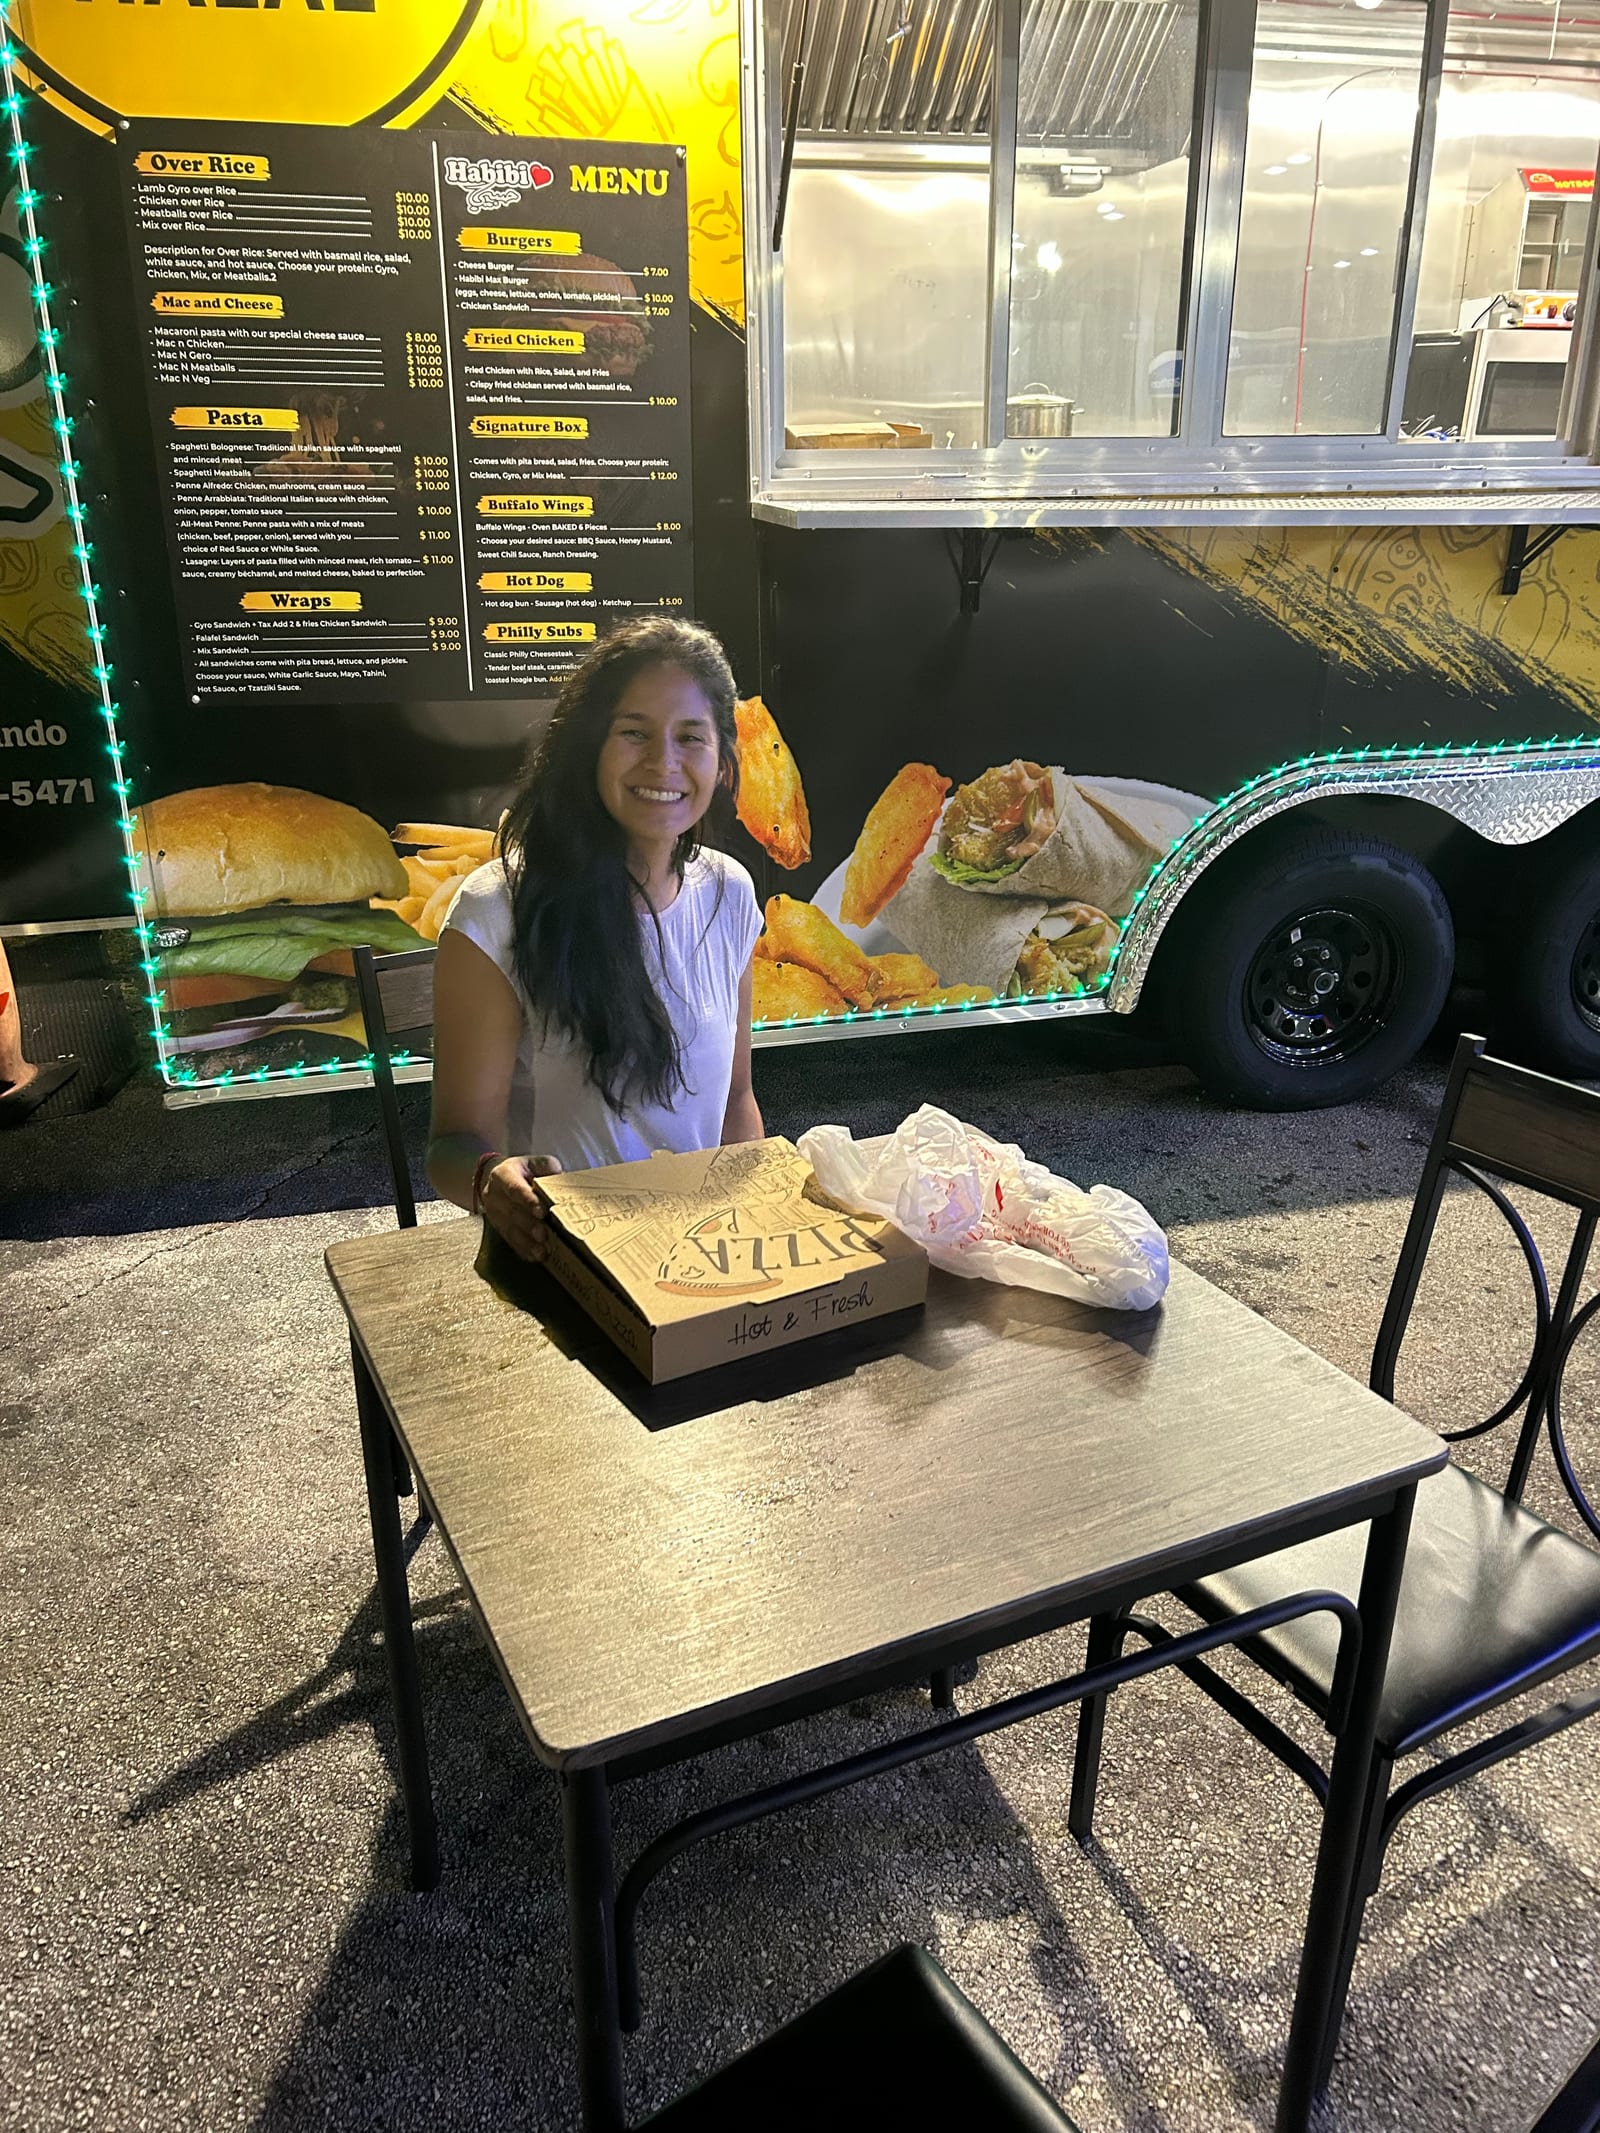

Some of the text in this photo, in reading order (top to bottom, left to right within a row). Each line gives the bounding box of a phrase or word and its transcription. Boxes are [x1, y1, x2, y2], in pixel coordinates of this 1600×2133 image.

[150, 154, 255, 174] Over Rice
[445, 158, 530, 186] Habibi
[569, 165, 669, 196] MENU
[137, 183, 429, 204] Lamb Gyro over Rice $10.00
[139, 195, 430, 216] Chicken over Rice $10.00
[140, 208, 431, 228] Meatballs over Rice $10.00
[142, 220, 432, 240] Mix over Rice $10.00
[487, 232, 552, 250] Burgers
[144, 244, 412, 265] Description for Over Rice: Served with basmati rice, salad,
[145, 256, 399, 276] white sauce, and hot sauce. Choose your protein: Gyro,
[458, 260, 487, 270] Cheese
[487, 261, 515, 272] Burger
[147, 269, 189, 281] Chicken,
[190, 270, 210, 281] Mix,
[211, 272, 222, 280] or
[458, 274, 529, 286] Habibi Max Burger
[161, 296, 273, 310] Mac and Cheese
[460, 301, 492, 311] Chicken
[492, 302, 530, 312] Sandwich
[154, 326, 199, 336] Macaroni
[200, 328, 227, 338] pasta
[227, 328, 250, 338] with
[251, 330, 268, 338] our
[269, 329, 302, 340] special
[303, 330, 336, 340] cheese
[337, 333, 365, 341] sauce
[474, 333, 574, 347] Fried Chicken
[156, 338, 176, 348] Mac
[178, 340, 185, 348] n
[186, 339, 225, 349] Chicken
[157, 350, 178, 360] Mac
[179, 351, 187, 360] N
[159, 362, 179, 371] Mac
[180, 362, 189, 371] N
[190, 363, 236, 372] Meatballs
[160, 374, 181, 383] Mac
[182, 374, 190, 383] N
[191, 374, 211, 385] Veg
[466, 394, 489, 404] salad,
[489, 395, 504, 403] and
[504, 395, 523, 403] fries.
[206, 409, 264, 426] Pasta
[476, 419, 582, 435] Signature Box
[173, 456, 189, 464] and
[190, 455, 221, 464] minced
[173, 469, 213, 478] Spaghetti
[213, 469, 252, 477] Meatballs
[469, 471, 502, 480] Chicken,
[502, 472, 522, 481] Gyro,
[531, 471, 545, 479] Mix
[545, 472, 566, 480] Meat.
[202, 482, 233, 490] Alfredo:
[234, 482, 268, 491] Chicken,
[269, 482, 317, 491] mushrooms,
[488, 499, 585, 513] Buffalo Wings
[506, 575, 565, 589] Hot Dog
[270, 593, 332, 610] Wraps
[195, 634, 221, 642] Falafel
[222, 633, 259, 642] Sandwich
[497, 625, 583, 640] Philly Subs
[212, 647, 250, 655] Sandwich
[483, 650, 574, 659] Classic Philly Cheesesteak
[212, 685, 238, 693] Sauce,
[247, 684, 276, 692] Tzatziki
[0, 719, 67, 747] ndo
[685, 1217, 884, 1279] PIZZA
[727, 1280, 875, 1346] Hot & Fresh
